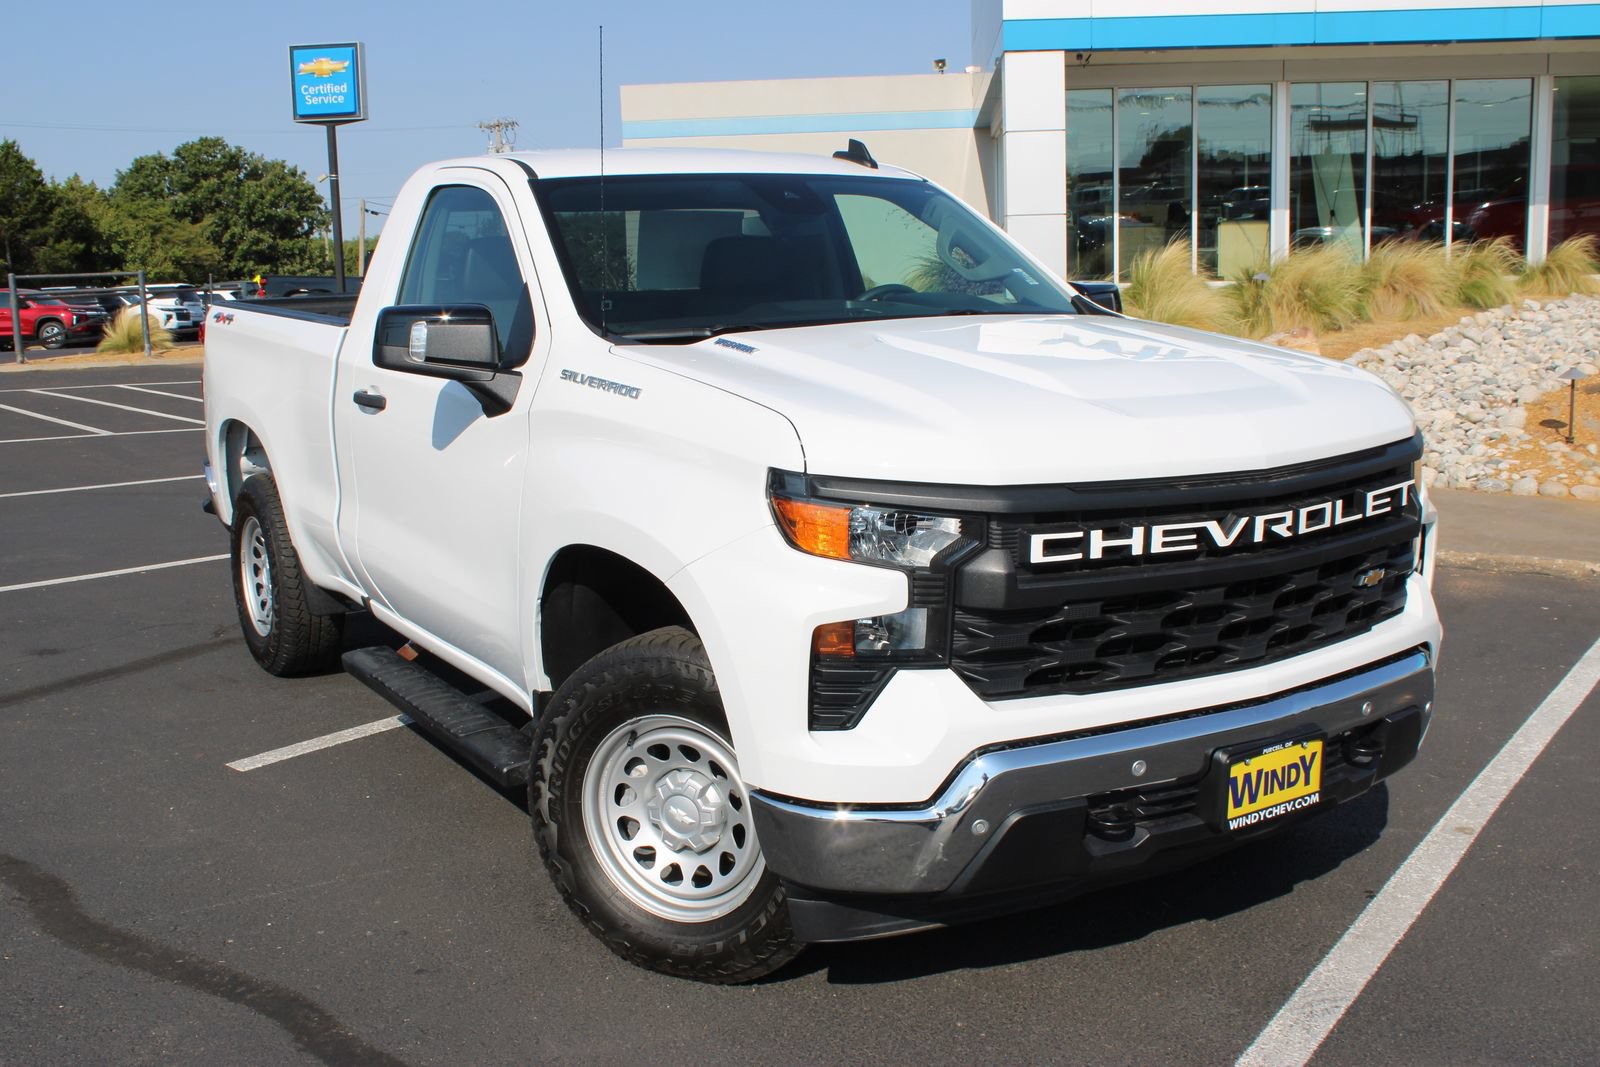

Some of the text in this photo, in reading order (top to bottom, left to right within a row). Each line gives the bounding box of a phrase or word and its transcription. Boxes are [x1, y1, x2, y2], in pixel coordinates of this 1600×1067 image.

[301, 83, 347, 95] Certified
[305, 94, 345, 105] Service
[560, 368, 642, 400] SILVERADO
[1029, 479, 1416, 564] CHEVROLET
[1228, 750, 1318, 810] WINDY
[1228, 793, 1320, 830] WINDYCHEV.COM
